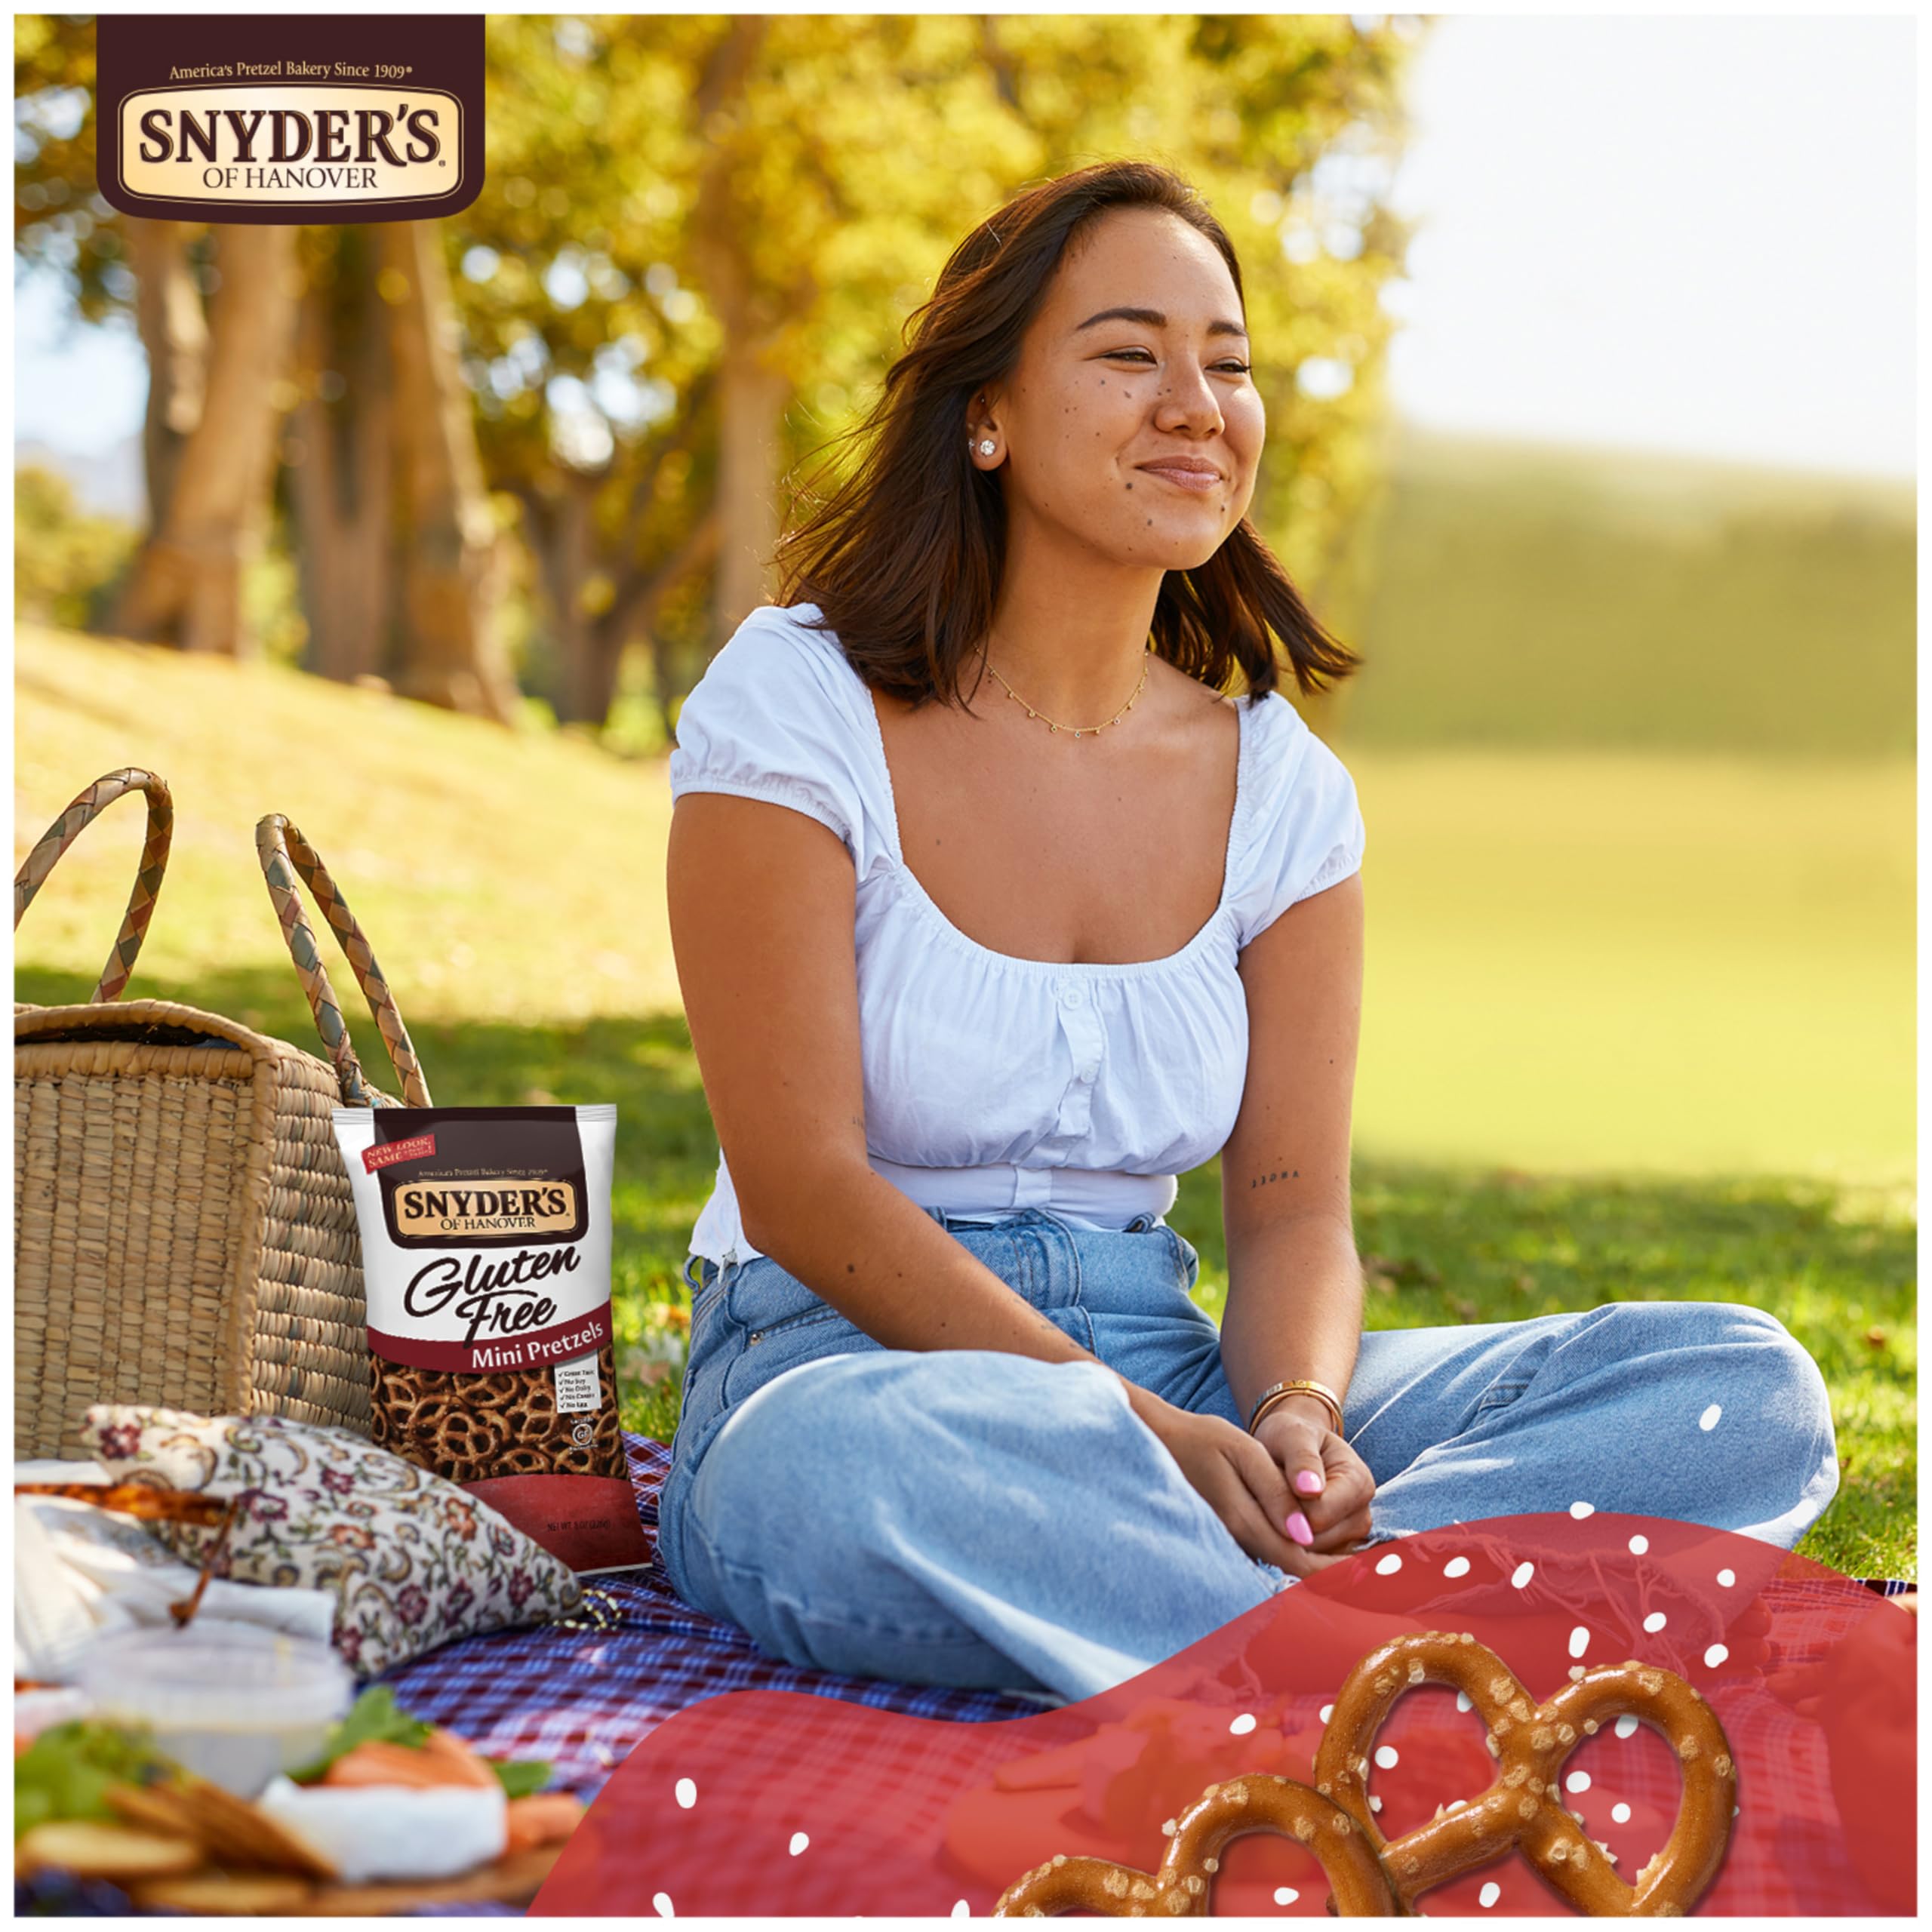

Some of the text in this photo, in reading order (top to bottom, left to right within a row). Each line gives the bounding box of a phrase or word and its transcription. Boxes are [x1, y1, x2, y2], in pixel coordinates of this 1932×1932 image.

[368, 1146, 392, 1158] NEW
[368, 1152, 402, 1169] SAME
[440, 1216, 537, 1231] OF HANOVER
[404, 1246, 581, 1318] Gluten
[454, 1289, 558, 1349] Free
[472, 1321, 605, 1369] Mini Pretzels
